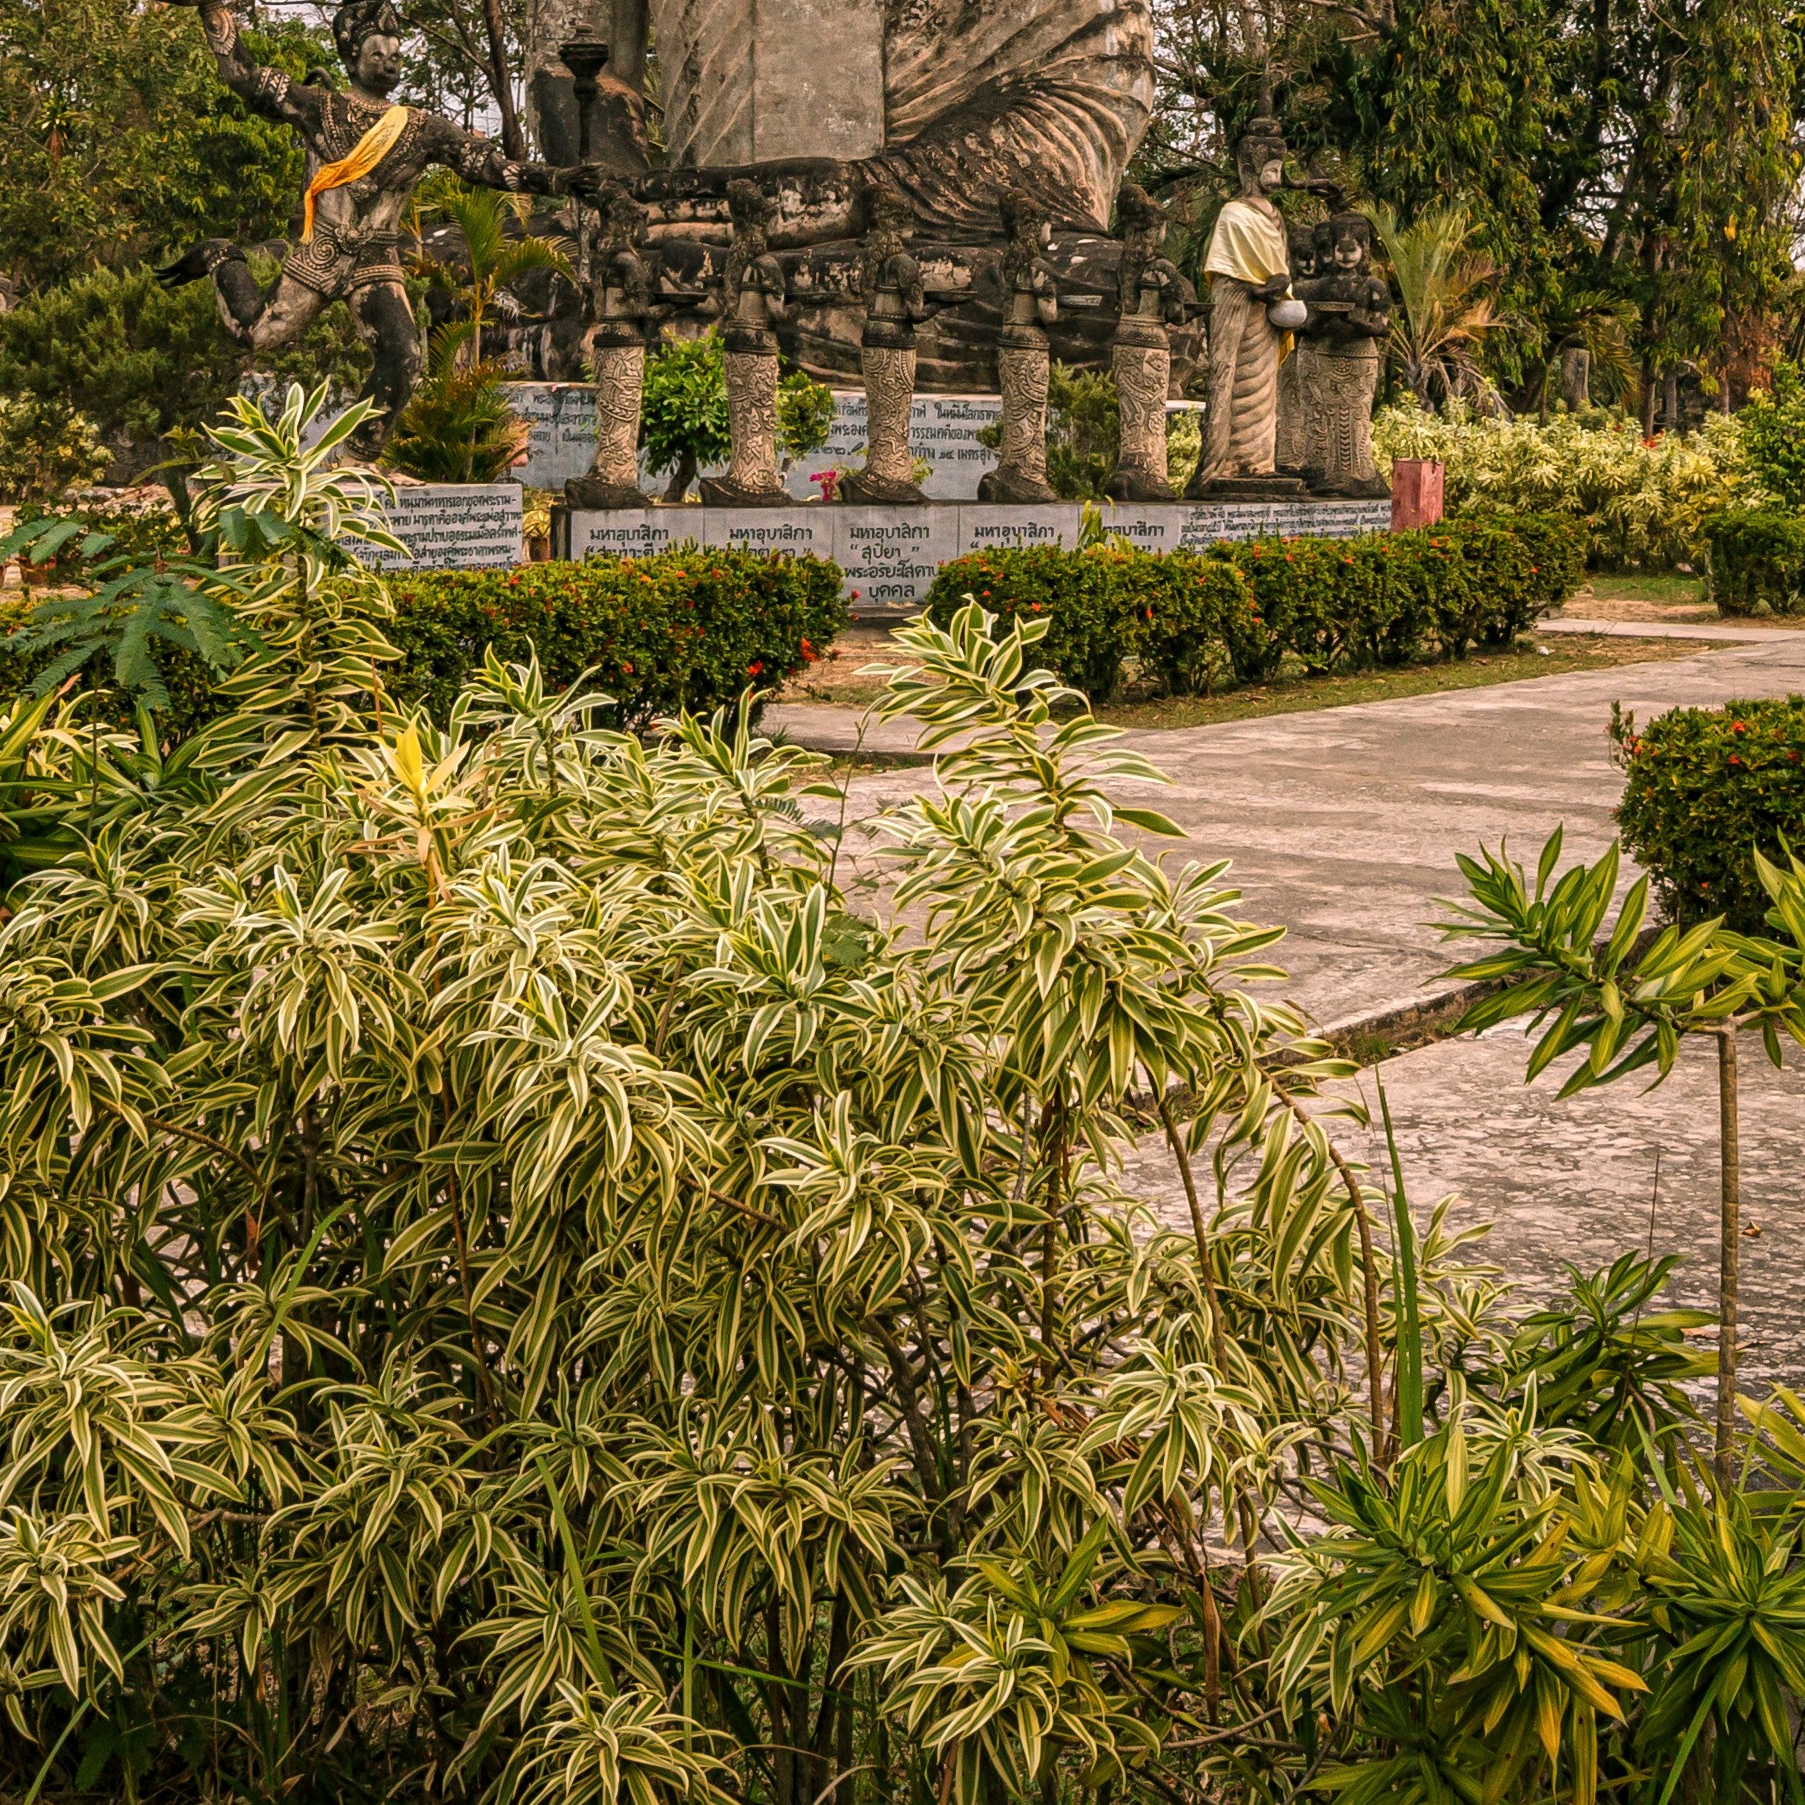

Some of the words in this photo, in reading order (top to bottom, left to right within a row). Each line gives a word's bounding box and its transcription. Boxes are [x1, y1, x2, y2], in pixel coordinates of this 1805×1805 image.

[850, 522, 930, 544] มหาอุบาสิกา
[868, 584, 915, 603] บุคคล
